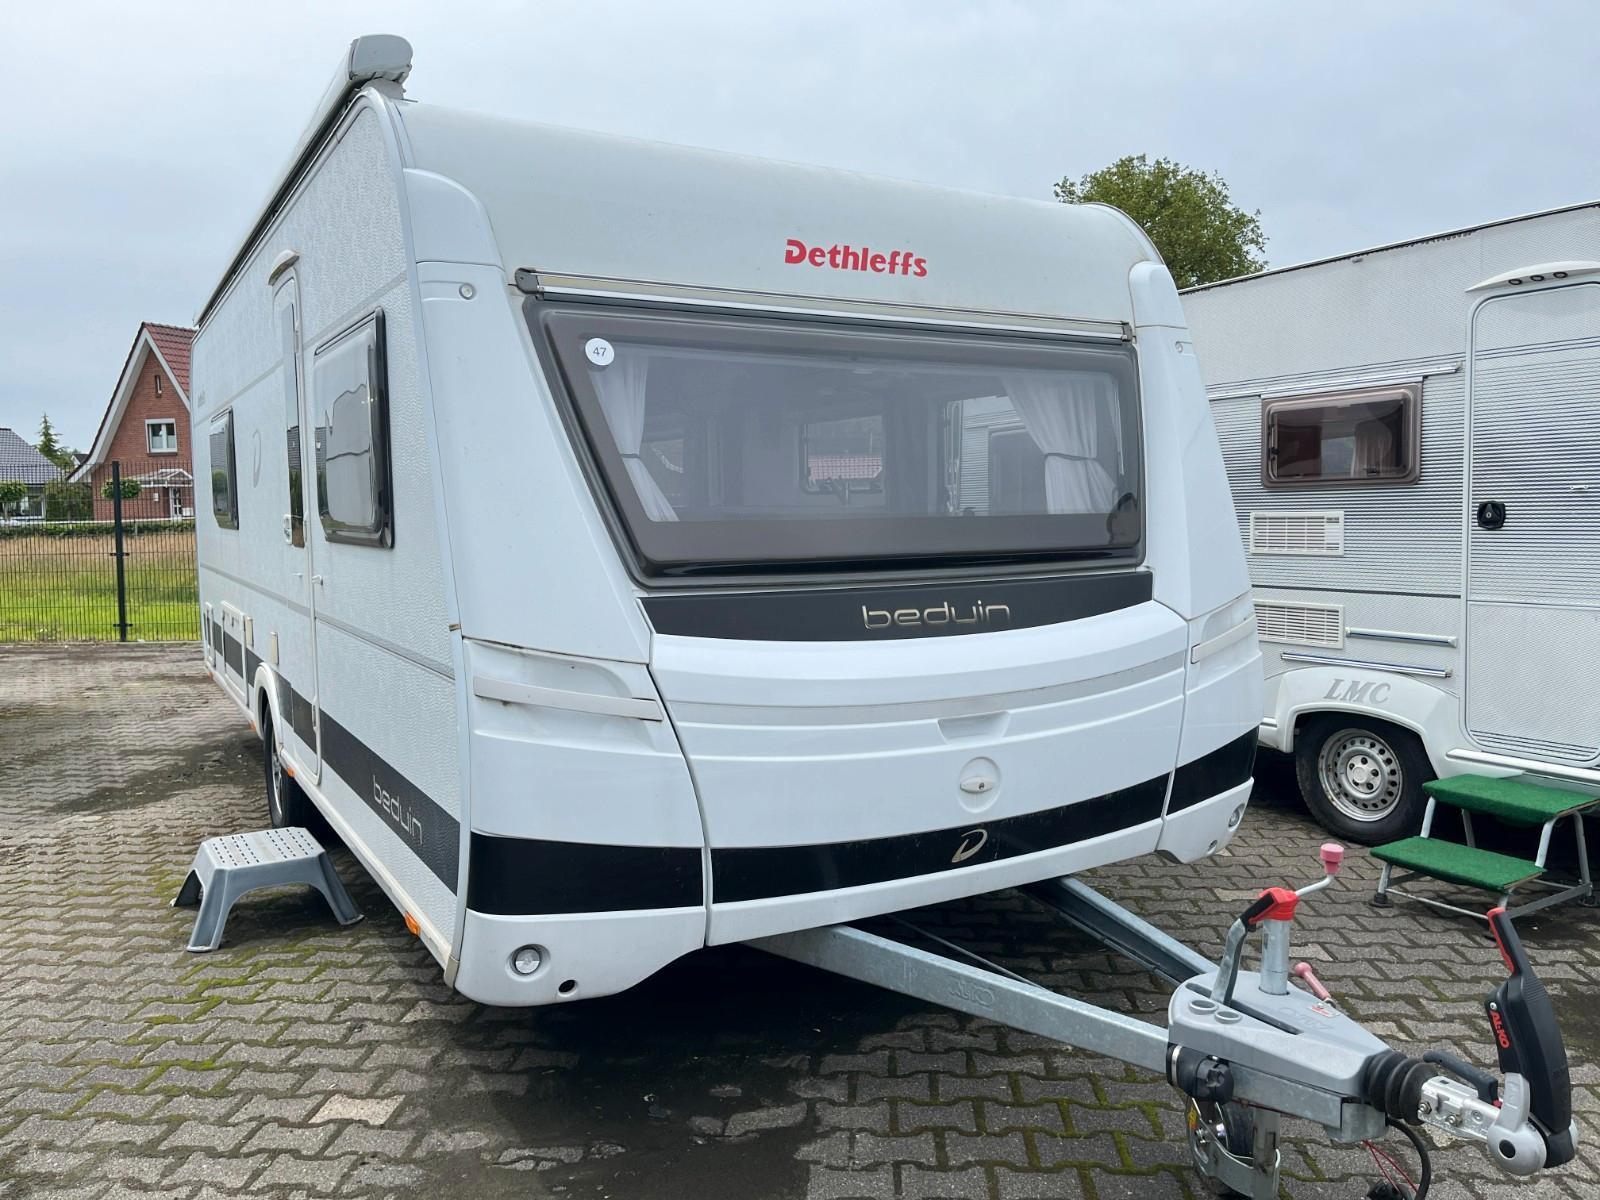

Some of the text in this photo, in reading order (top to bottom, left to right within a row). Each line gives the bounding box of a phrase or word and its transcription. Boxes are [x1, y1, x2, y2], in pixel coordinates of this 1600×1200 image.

[785, 239, 927, 277] Dethleffs
[592, 347, 607, 357] 47
[862, 600, 1010, 629] beduin
[1323, 679, 1391, 704] LMC
[373, 774, 423, 846] beduin
